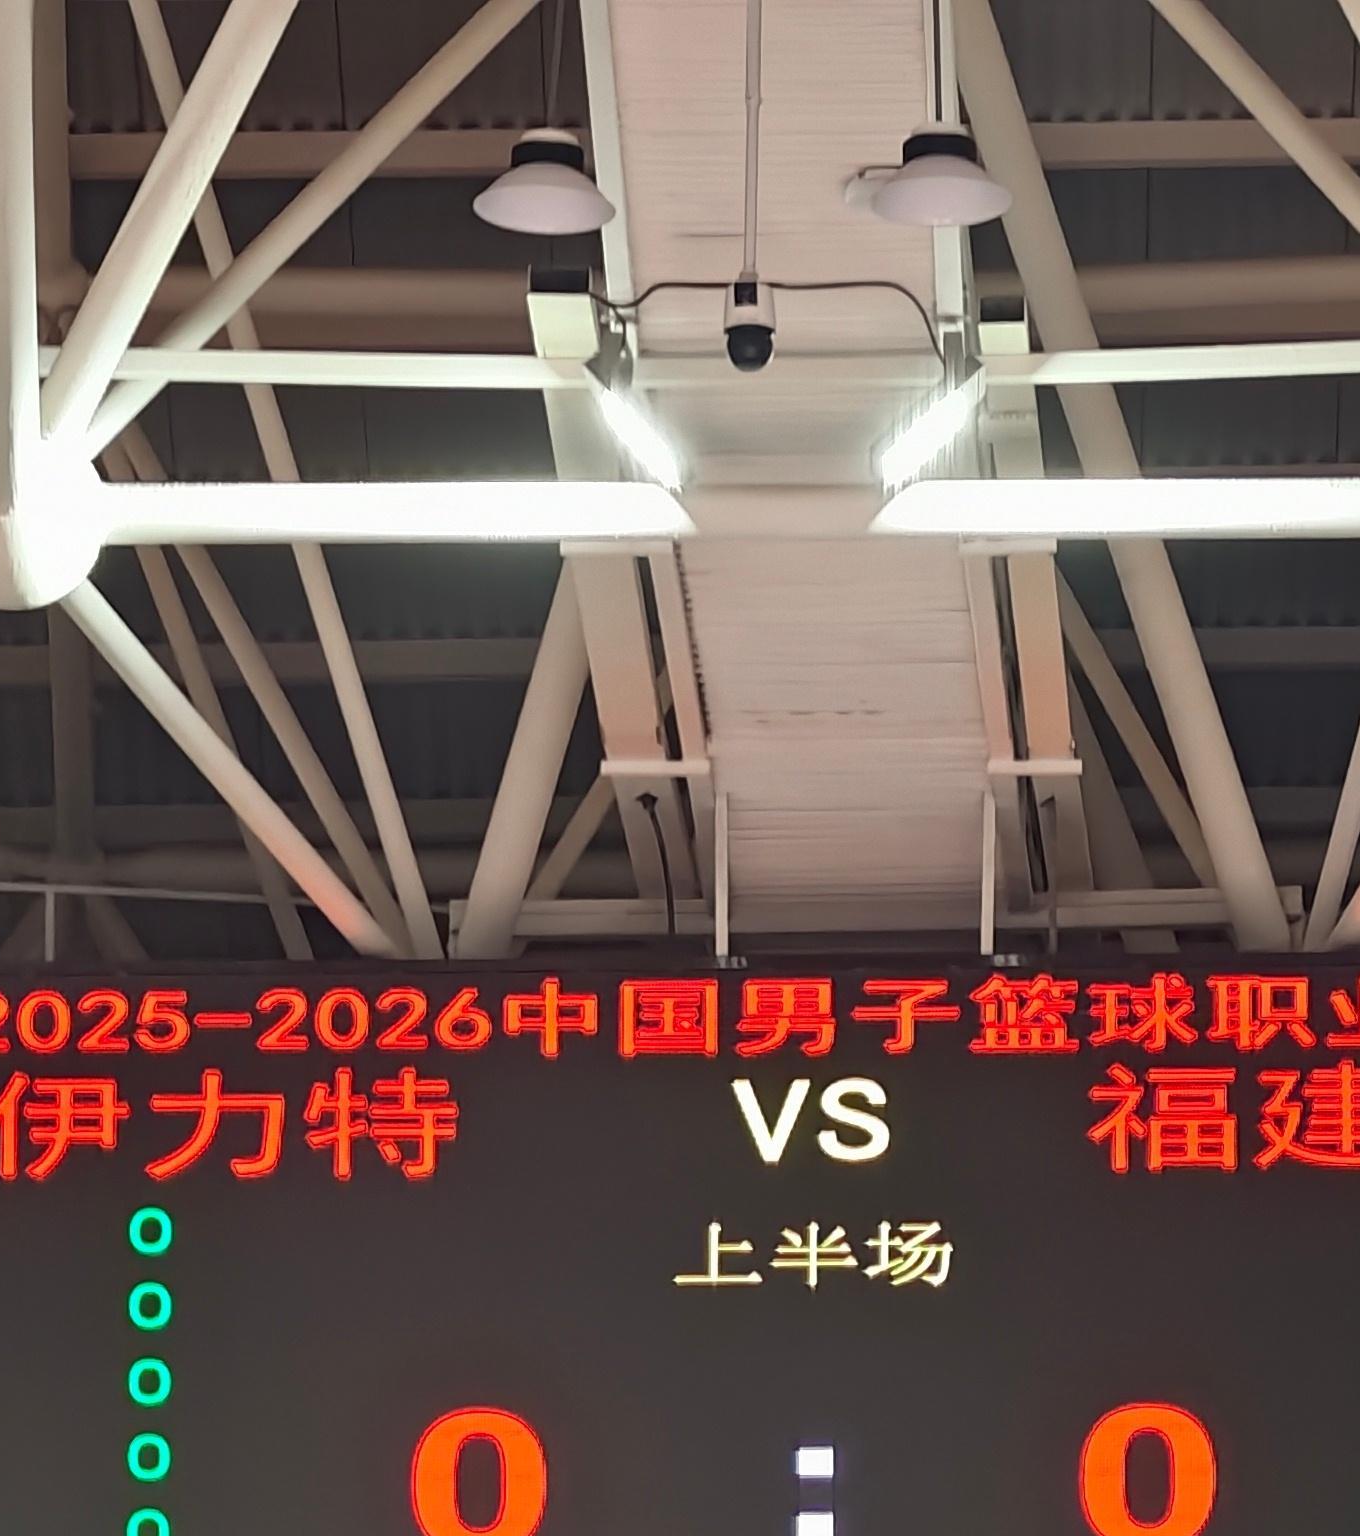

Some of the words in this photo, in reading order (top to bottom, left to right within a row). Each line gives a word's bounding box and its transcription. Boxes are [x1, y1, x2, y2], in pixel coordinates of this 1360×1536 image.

[732, 1077, 890, 1163] VS
[127, 1206, 175, 1257] 0
[673, 1221, 953, 1289] 上半场
[127, 1280, 174, 1332] 0
[126, 1356, 174, 1408] 0
[125, 1432, 173, 1483] 0
